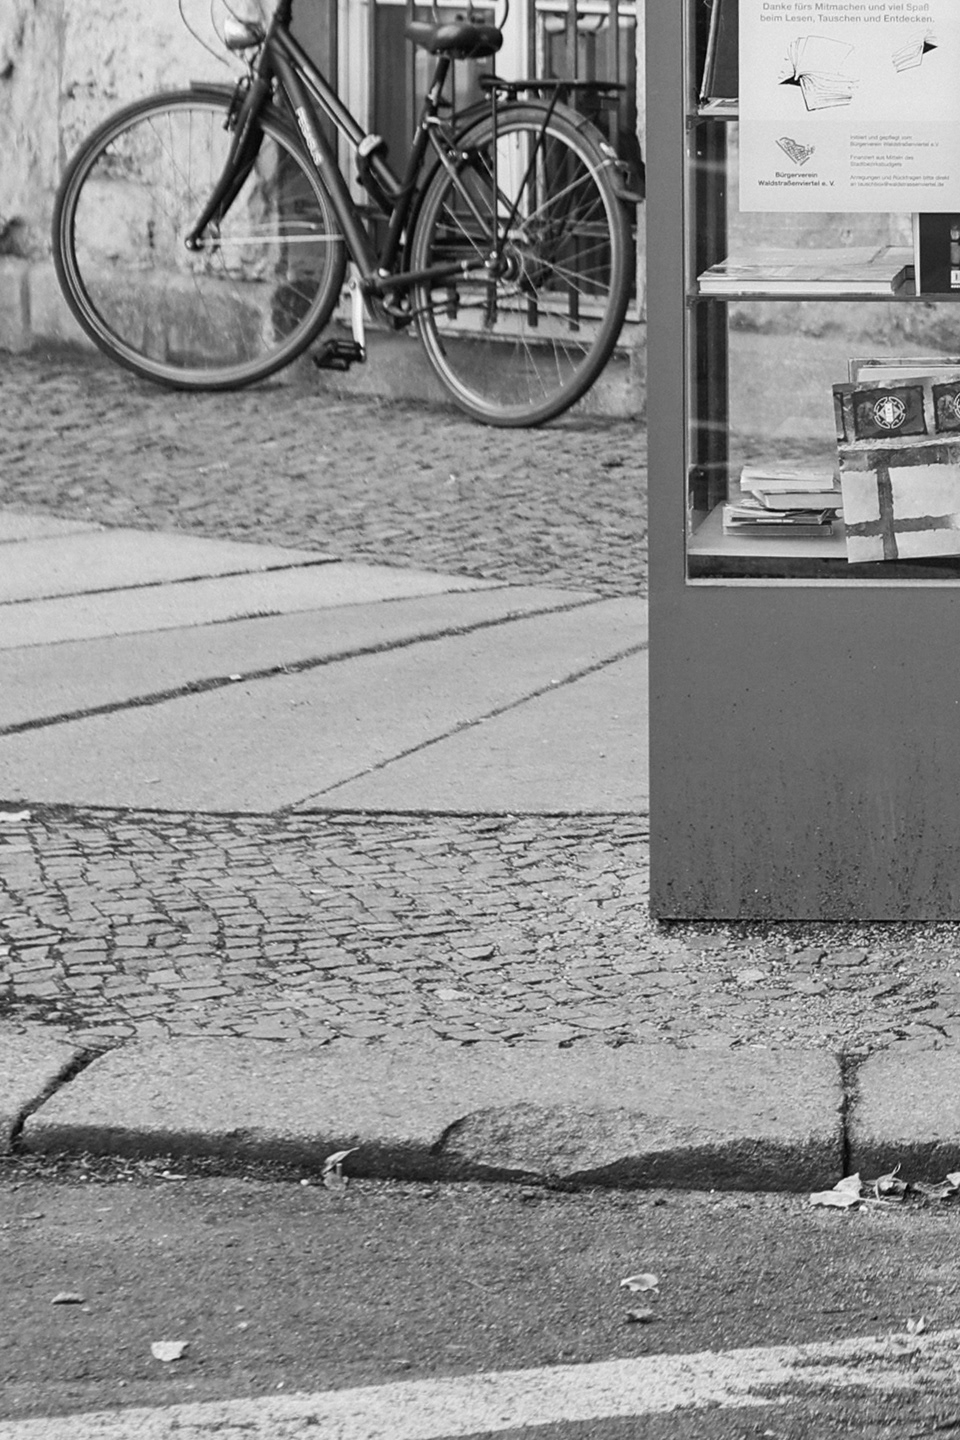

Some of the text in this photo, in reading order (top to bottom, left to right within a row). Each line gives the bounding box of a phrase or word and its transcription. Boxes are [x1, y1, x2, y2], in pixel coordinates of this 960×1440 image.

[906, 3, 929, 12] Spaß
[760, 14, 935, 23] beim Lesen, Tauschen und Entdecken.
